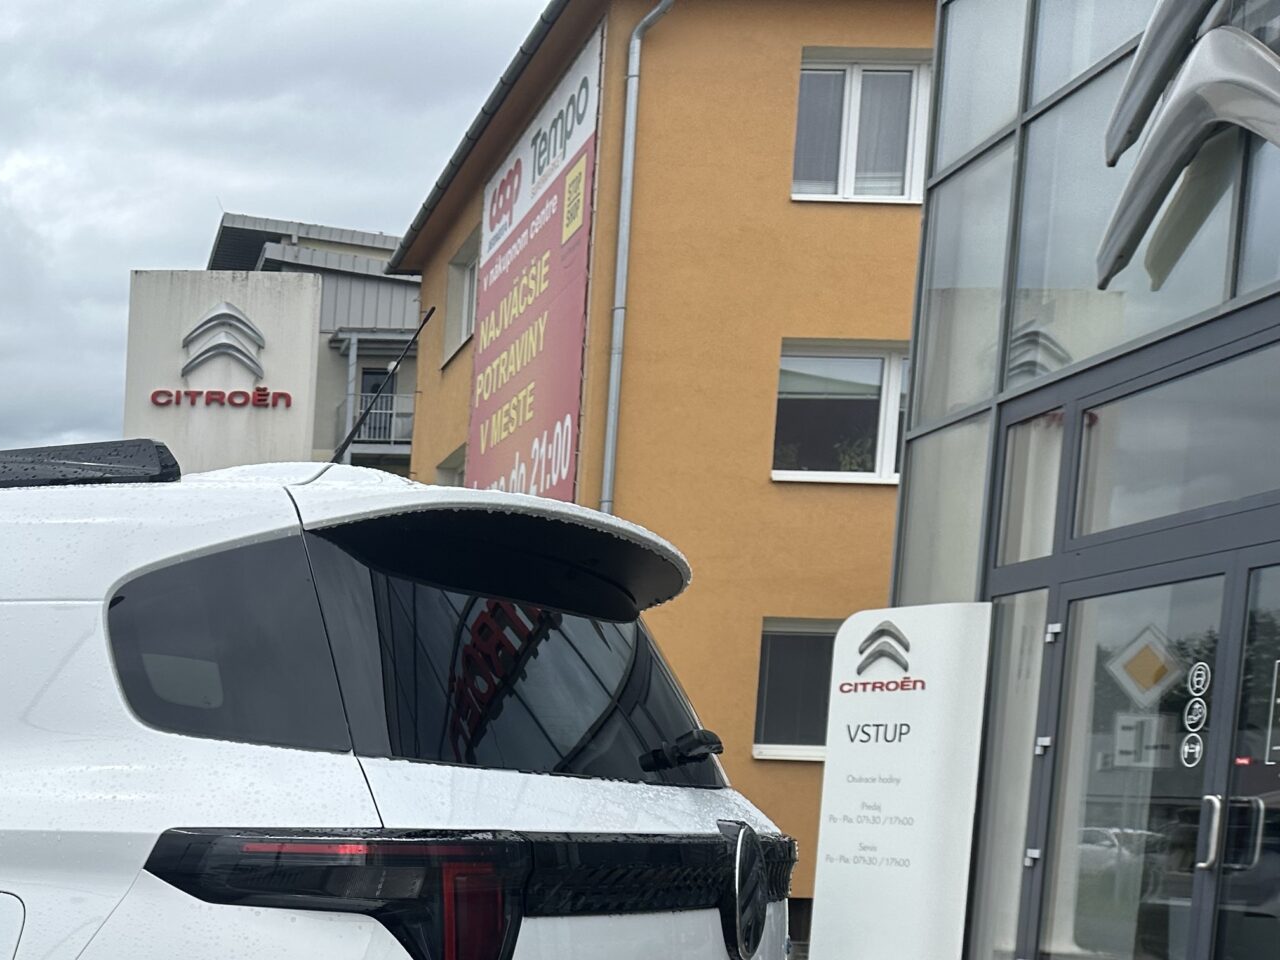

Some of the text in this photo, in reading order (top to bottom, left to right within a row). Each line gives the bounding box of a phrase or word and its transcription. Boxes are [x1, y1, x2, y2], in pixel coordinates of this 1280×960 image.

[530, 76, 590, 186] Tempo
[478, 250, 552, 354] NAJVÄČŠIE
[475, 311, 549, 408] POTRAVINY
[479, 381, 536, 455] V MESTE
[529, 413, 572, 495] 21:00
[846, 723, 911, 744] VSTUP
